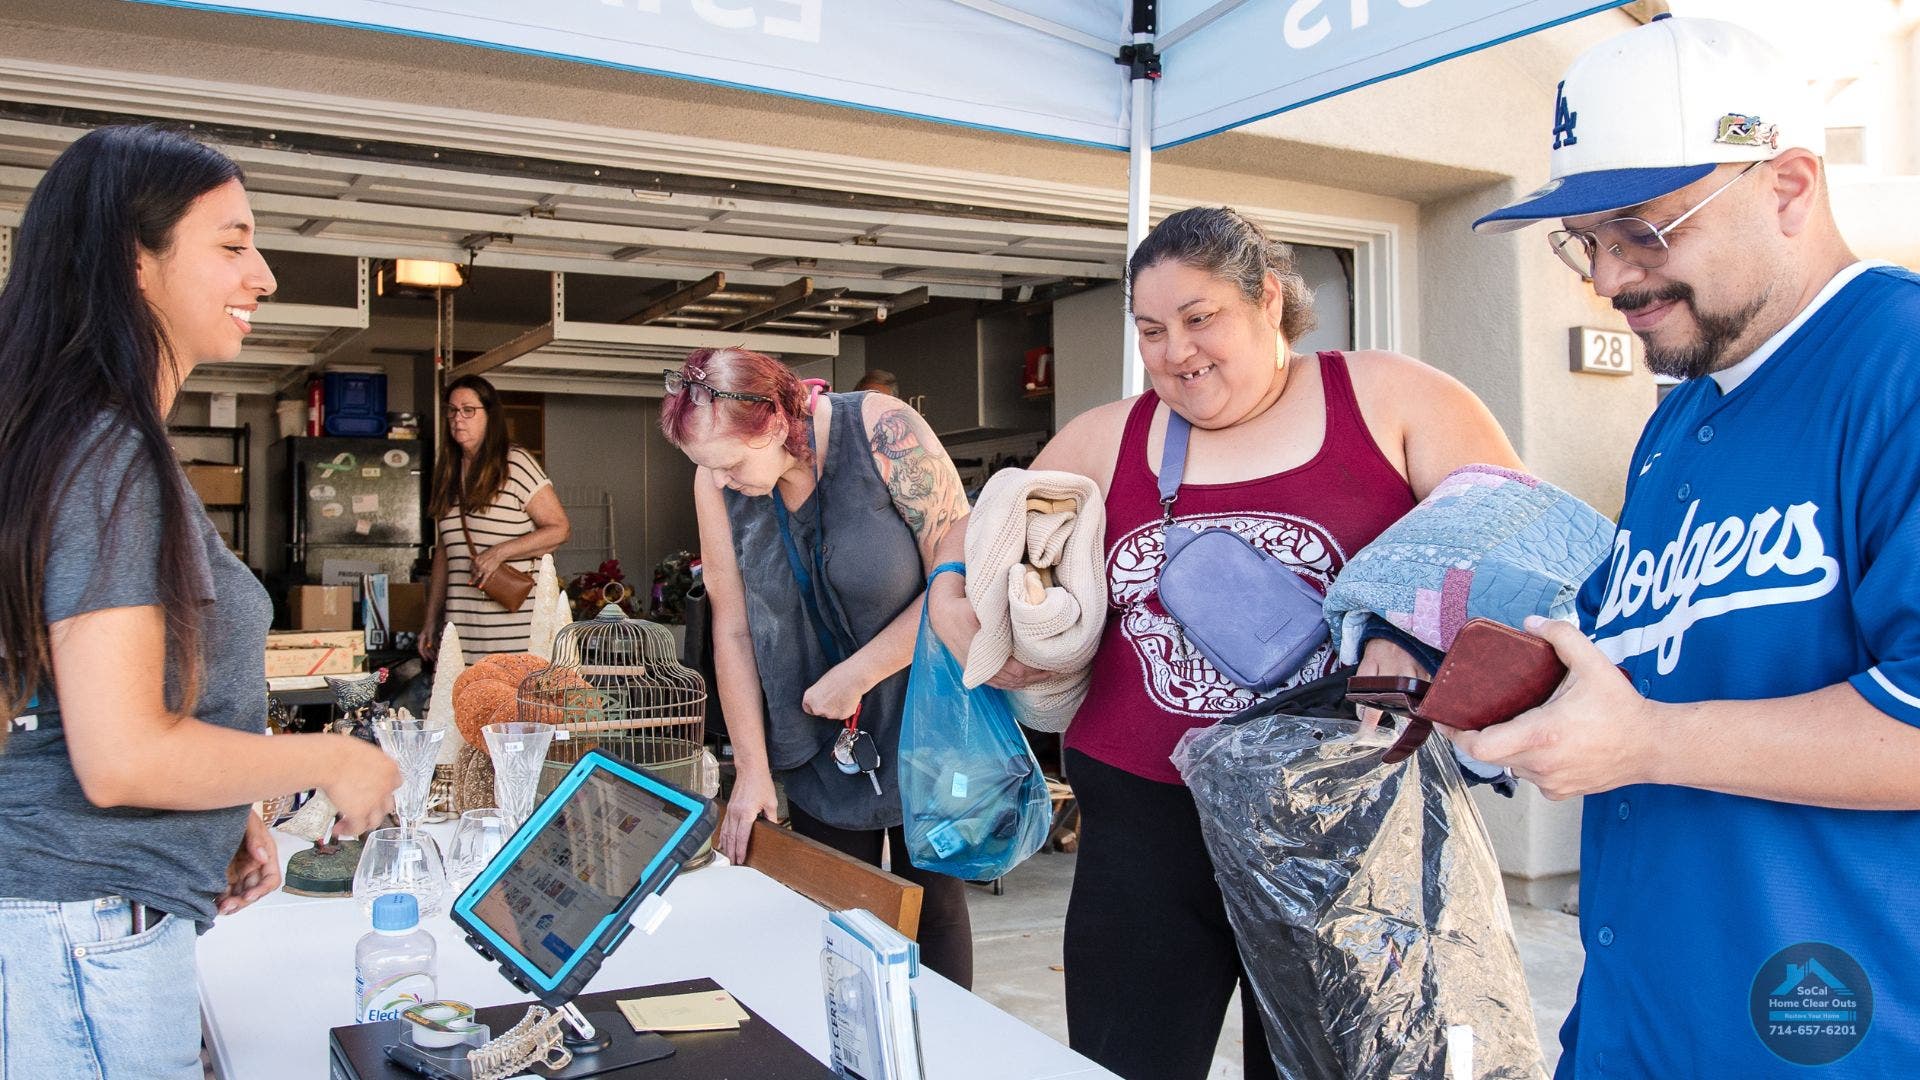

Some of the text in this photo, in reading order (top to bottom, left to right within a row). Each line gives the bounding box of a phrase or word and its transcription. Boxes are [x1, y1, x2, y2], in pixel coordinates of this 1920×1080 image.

[1552, 79, 1577, 150] LA
[1593, 334, 1623, 368] 28
[833, 1040, 844, 1079] GIFT
